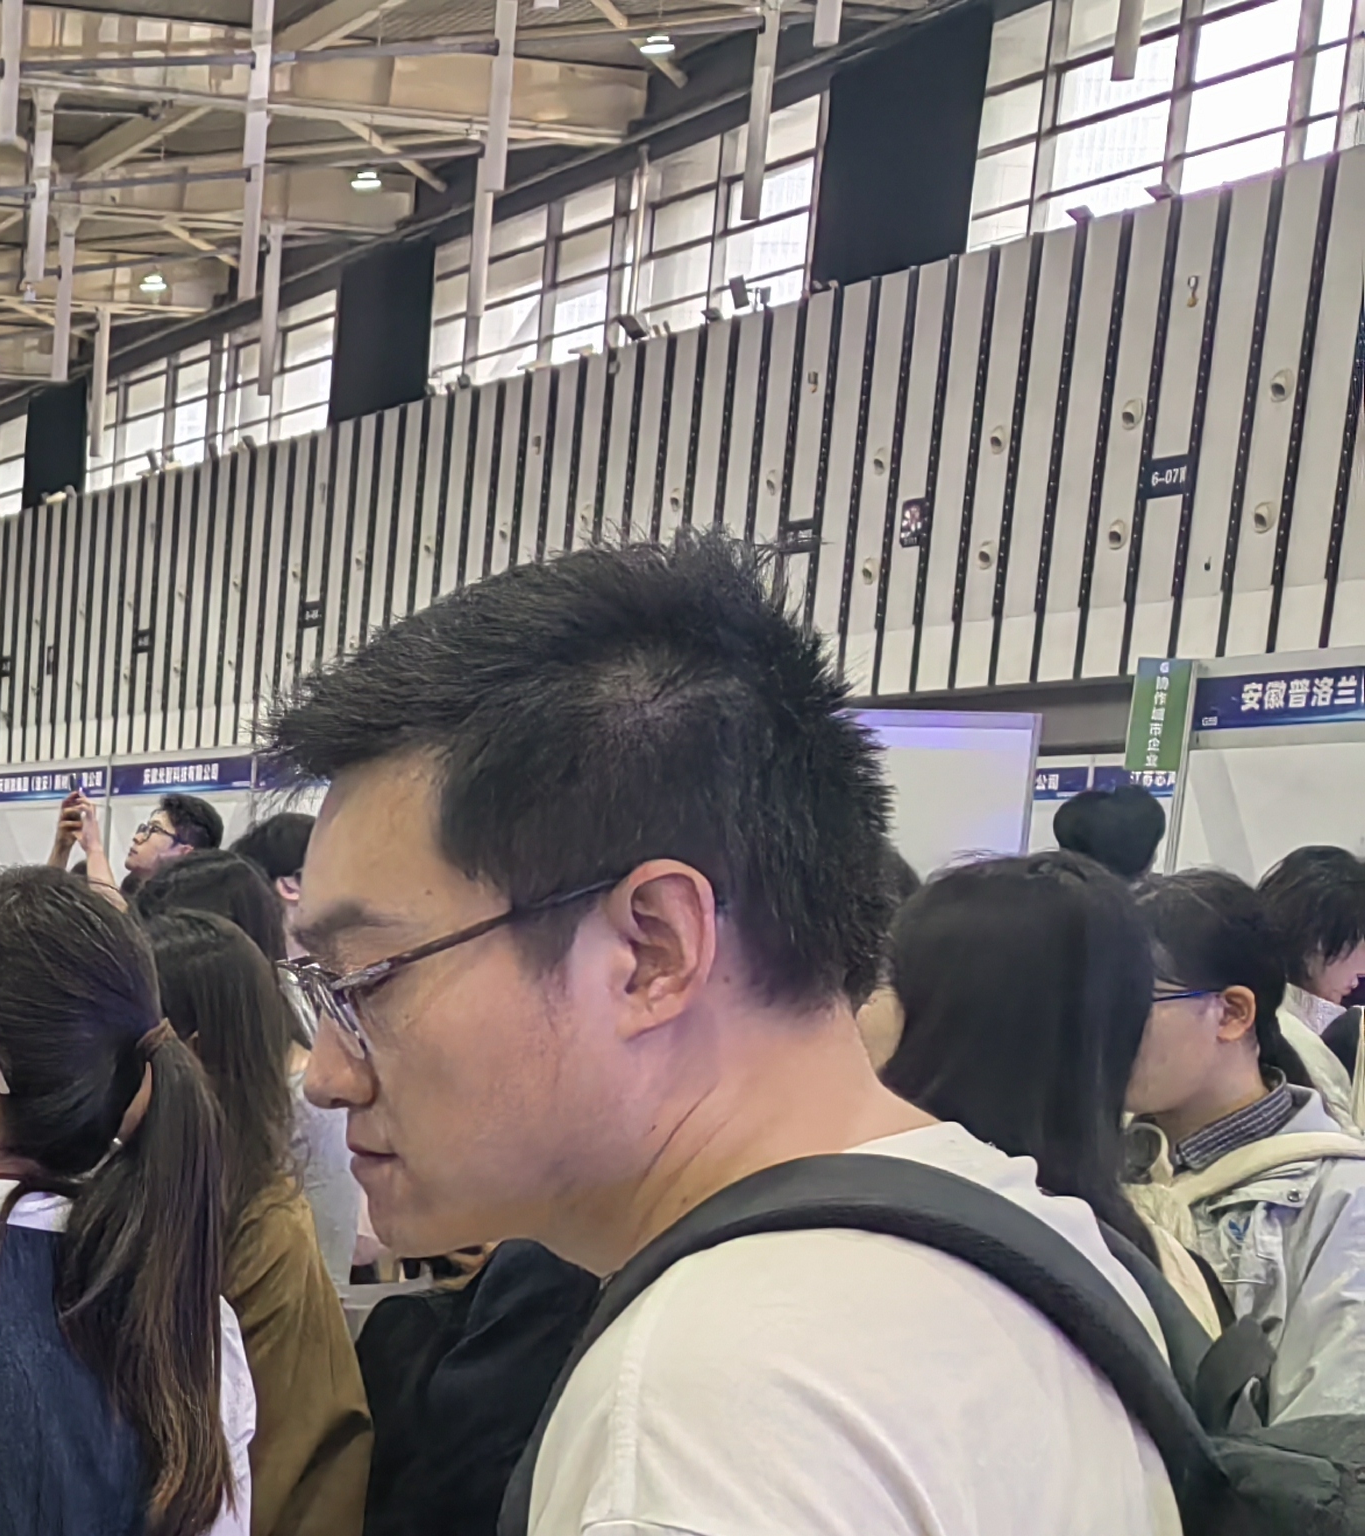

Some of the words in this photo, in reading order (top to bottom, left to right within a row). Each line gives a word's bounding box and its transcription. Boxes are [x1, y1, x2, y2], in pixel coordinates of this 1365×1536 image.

[1240, 675, 1358, 711] 安徽普洛兰
